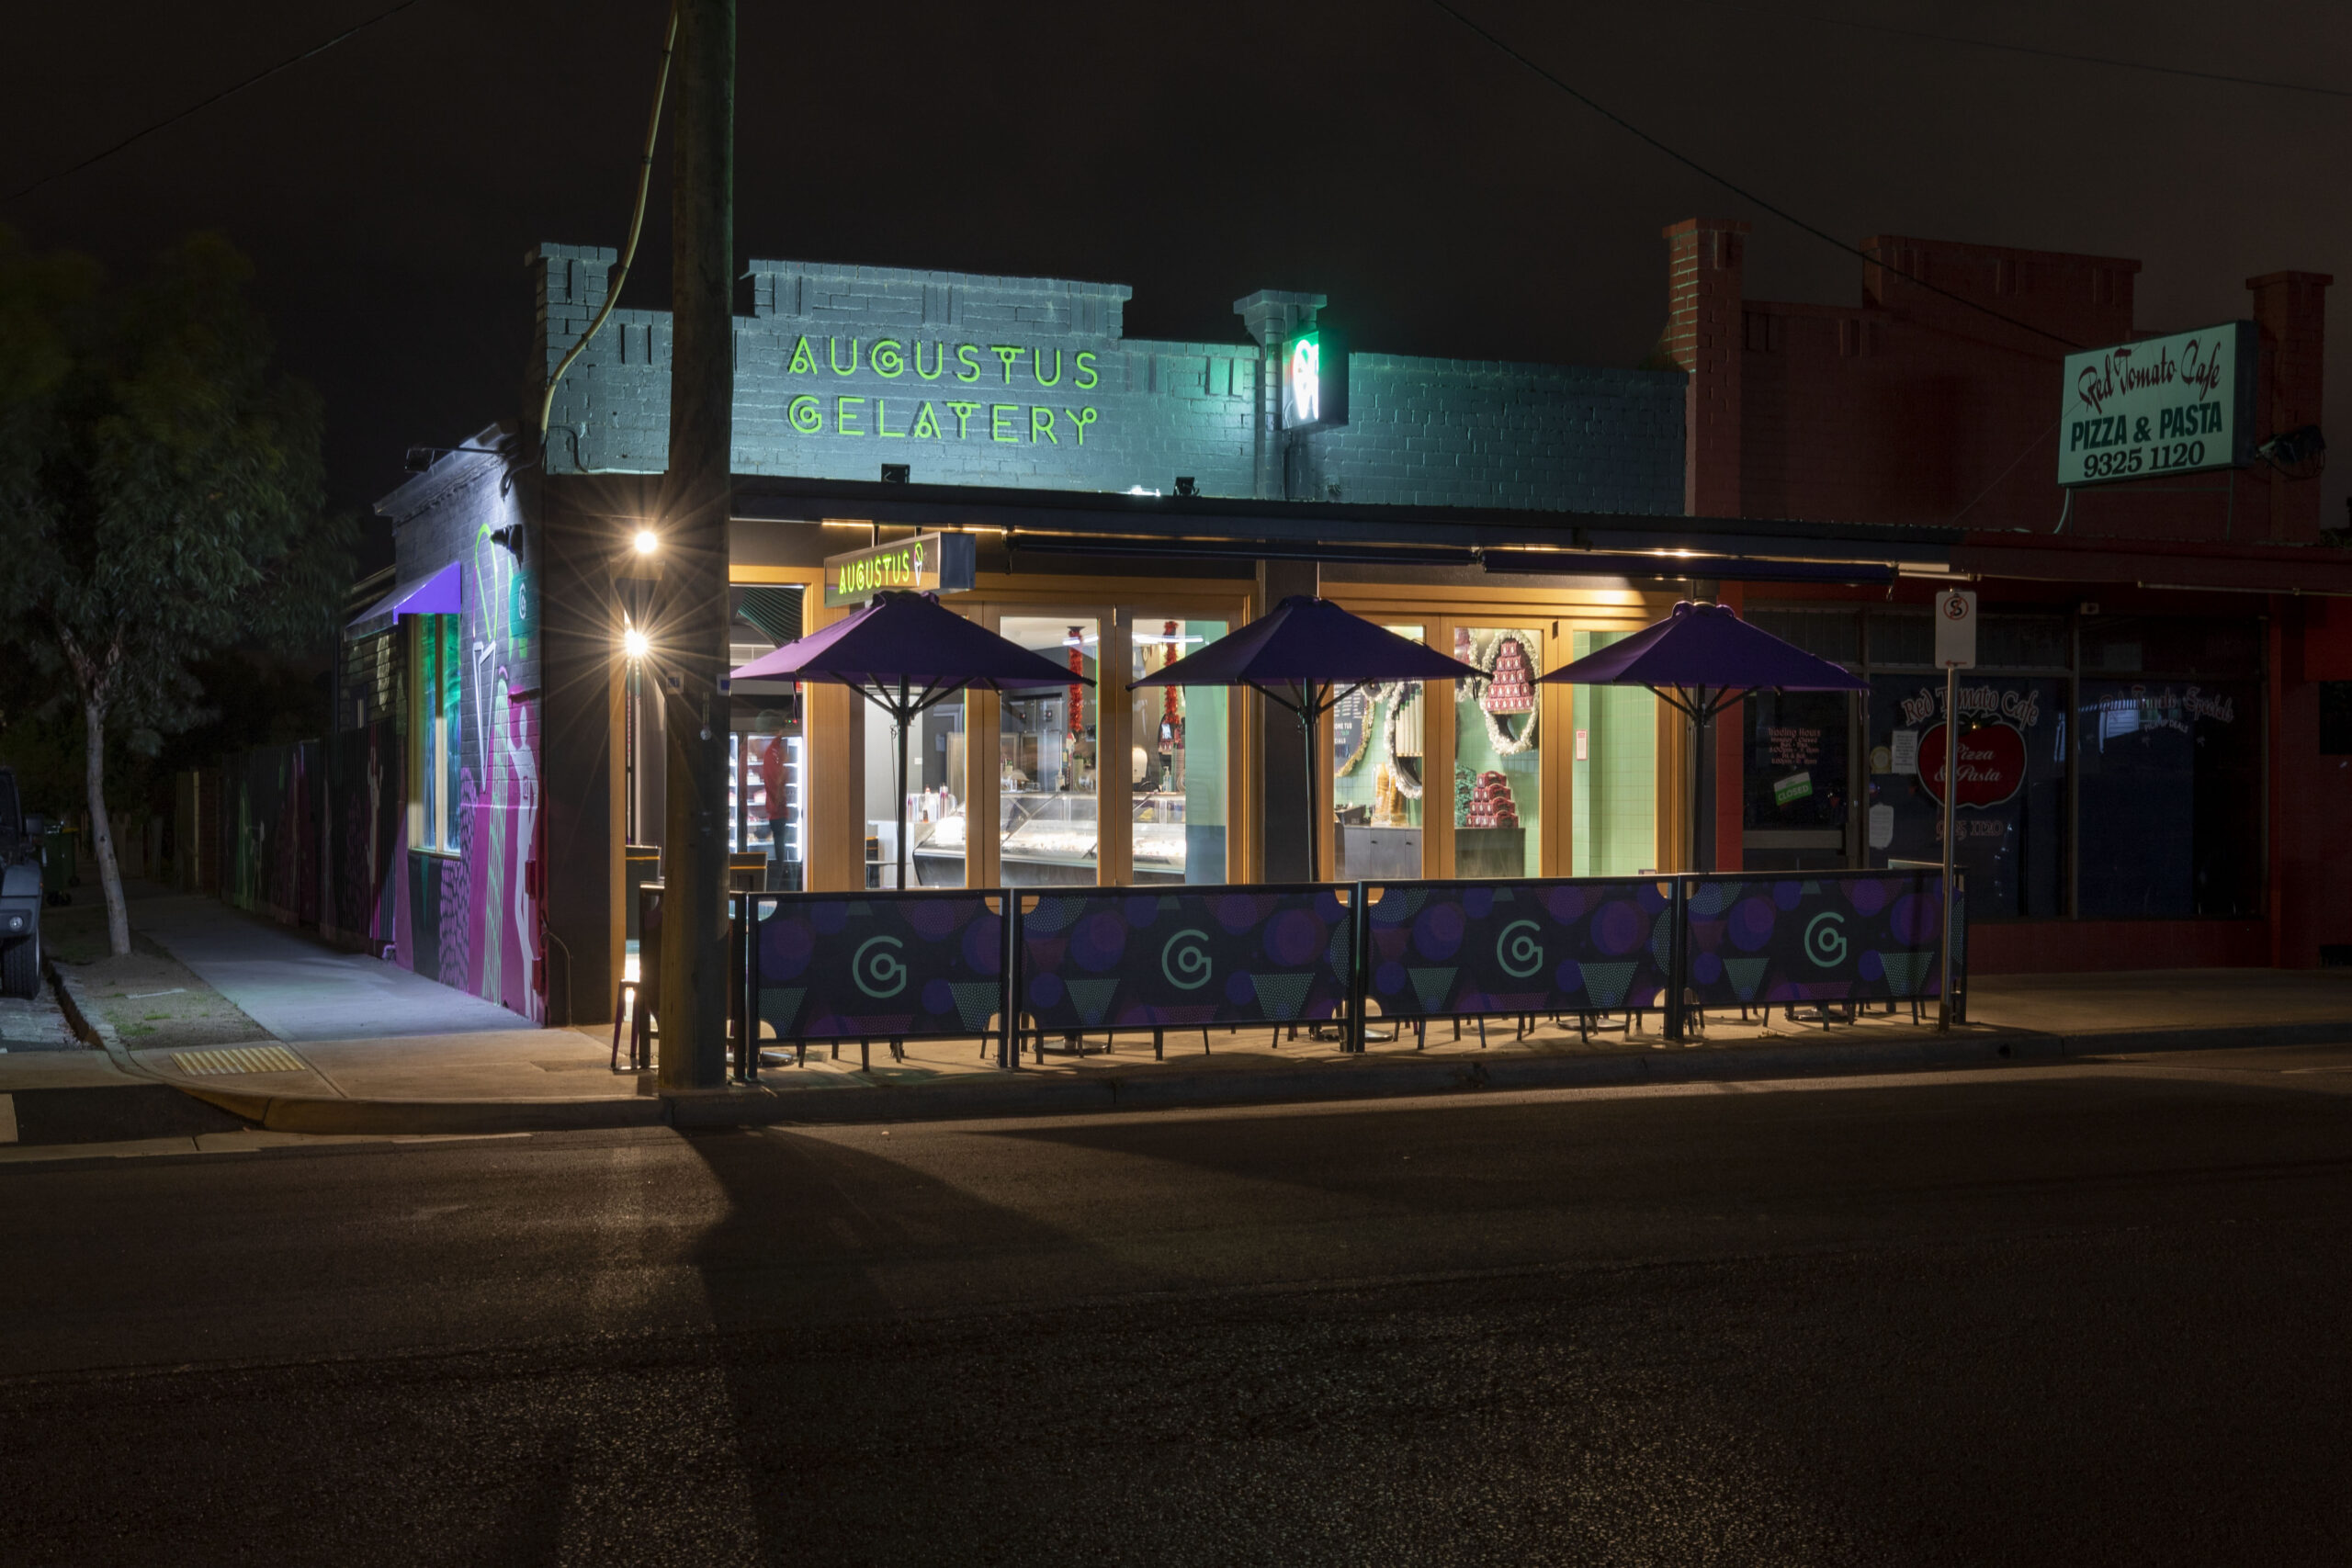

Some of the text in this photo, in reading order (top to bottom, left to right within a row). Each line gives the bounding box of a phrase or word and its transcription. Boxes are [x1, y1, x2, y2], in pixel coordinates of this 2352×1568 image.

[788, 335, 1099, 389] AUGUSTUS
[2078, 337, 2221, 414] Red Tomato Cafe
[788, 395, 1098, 446] GELATERY
[2070, 401, 2222, 451] PIZZA & PASTA
[2084, 441, 2205, 478] 9325 1120
[839, 548, 910, 595] AUGUSTUS
[1901, 684, 2040, 730] Red Tmato Cafe
[1778, 784, 1809, 801] CLOSED
[1955, 764, 2002, 782] Pasta
